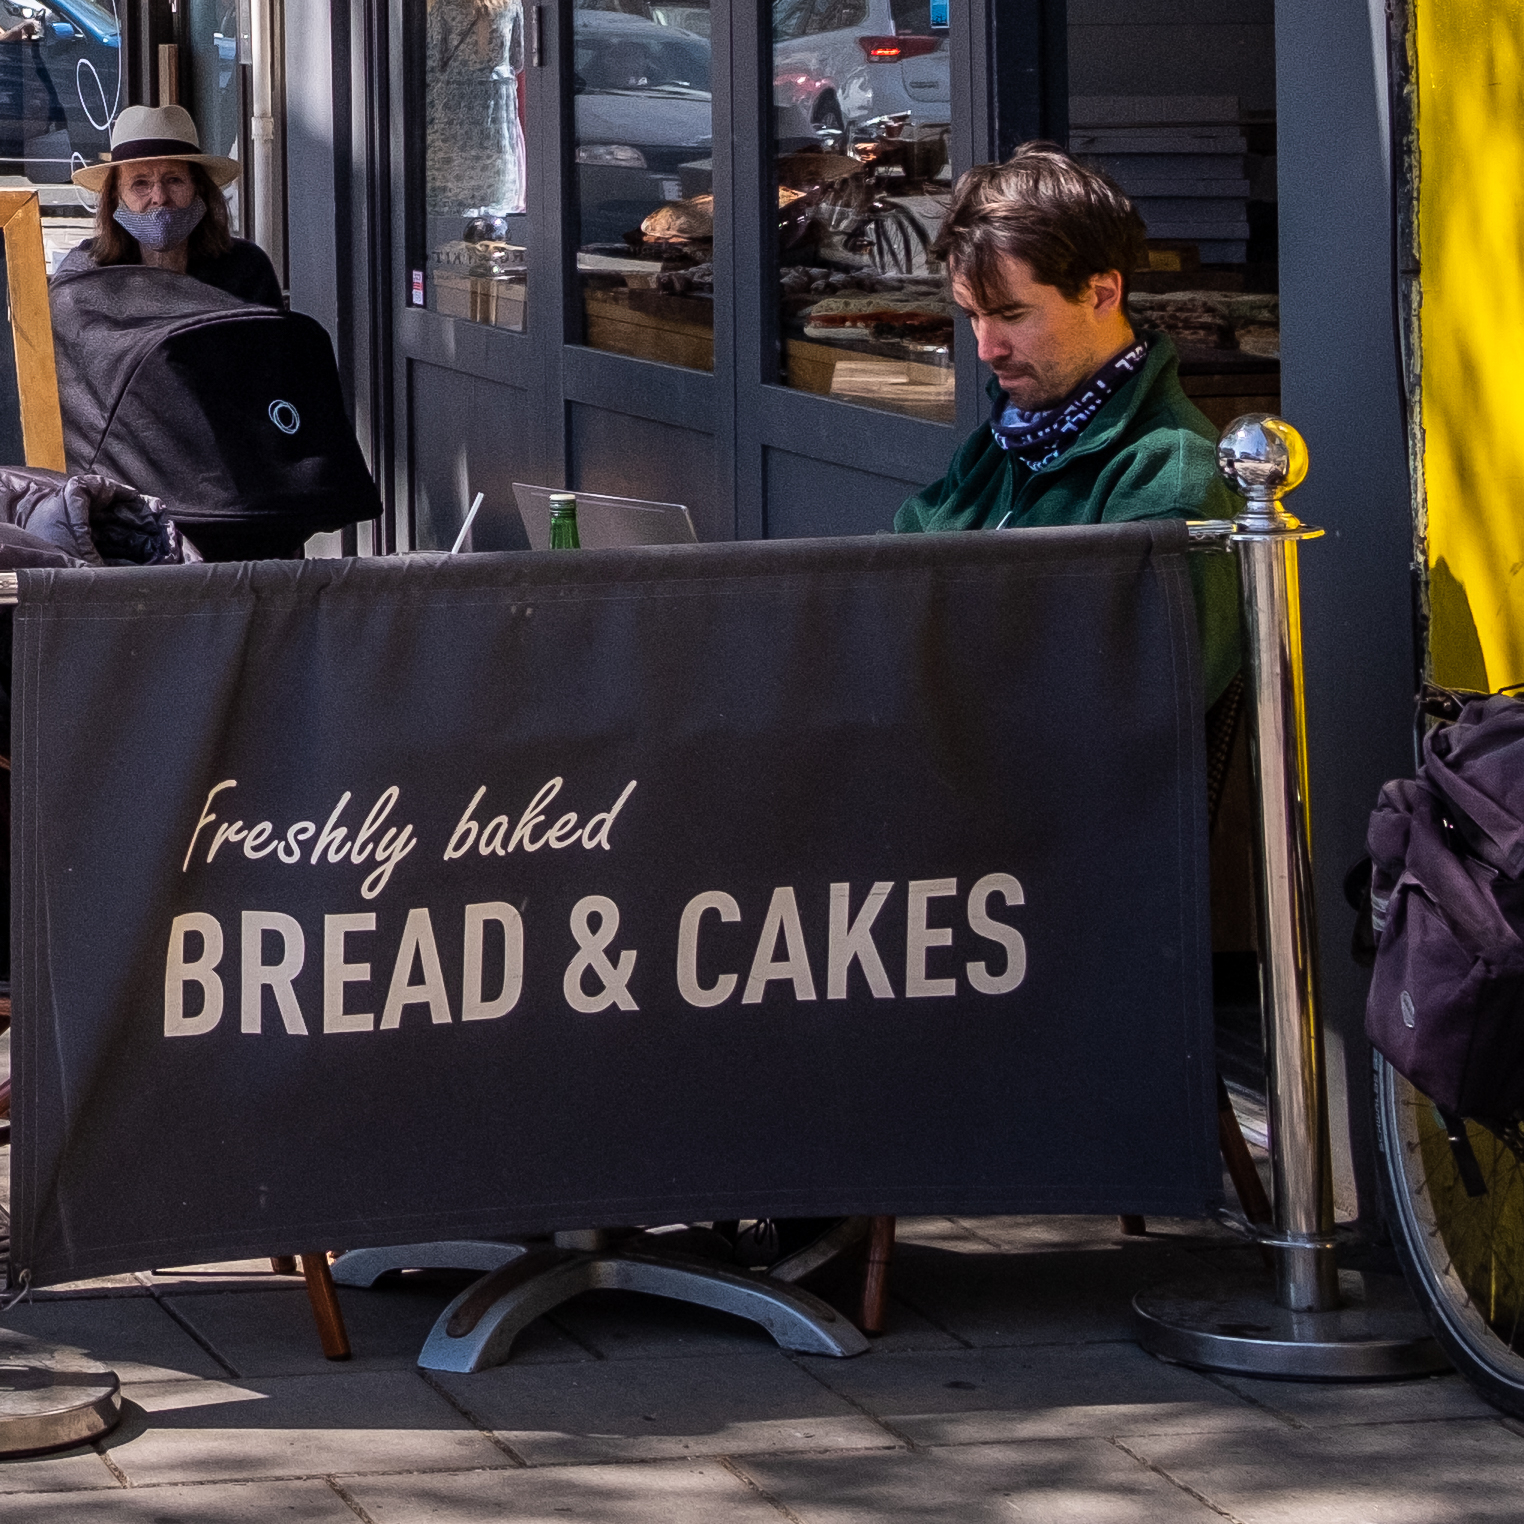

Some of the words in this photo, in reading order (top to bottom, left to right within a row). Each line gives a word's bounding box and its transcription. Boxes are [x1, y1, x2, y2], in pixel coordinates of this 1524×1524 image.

[182, 779, 417, 899] Freshly
[443, 777, 637, 862] baked
[163, 899, 525, 1037] BREAD
[563, 895, 640, 1013] &
[676, 872, 1027, 1007] CAKES
